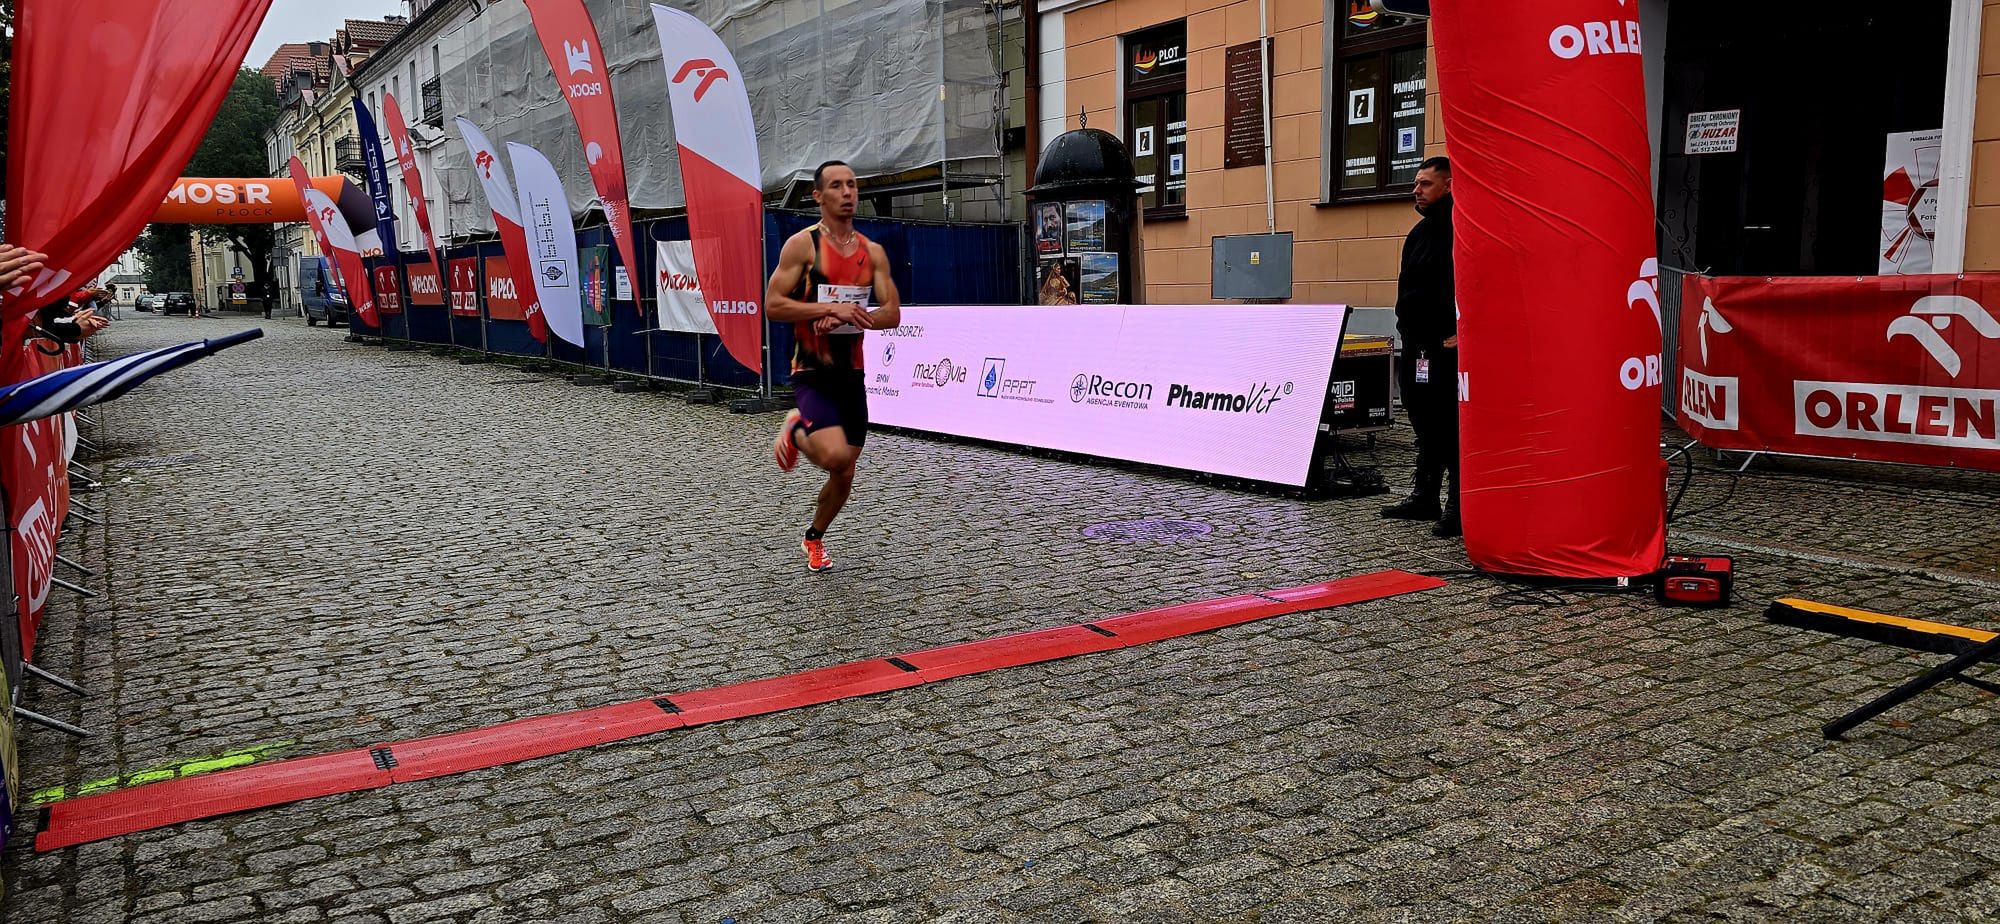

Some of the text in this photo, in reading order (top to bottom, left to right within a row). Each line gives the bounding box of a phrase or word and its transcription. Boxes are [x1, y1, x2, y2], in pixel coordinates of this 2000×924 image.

[1548, 20, 1641, 59] ORLE
[1159, 46, 1179, 61] PLOT
[1393, 79, 1426, 94] PAMIĄTKI
[1701, 127, 1737, 139] HUZAR
[216, 208, 272, 216] PŁOCK
[1088, 374, 1153, 400] Recon
[1086, 398, 1148, 409] AGENCJA EVENTOWA
[1684, 376, 1726, 421] RLEN
[1804, 389, 1996, 440] ORLEN
